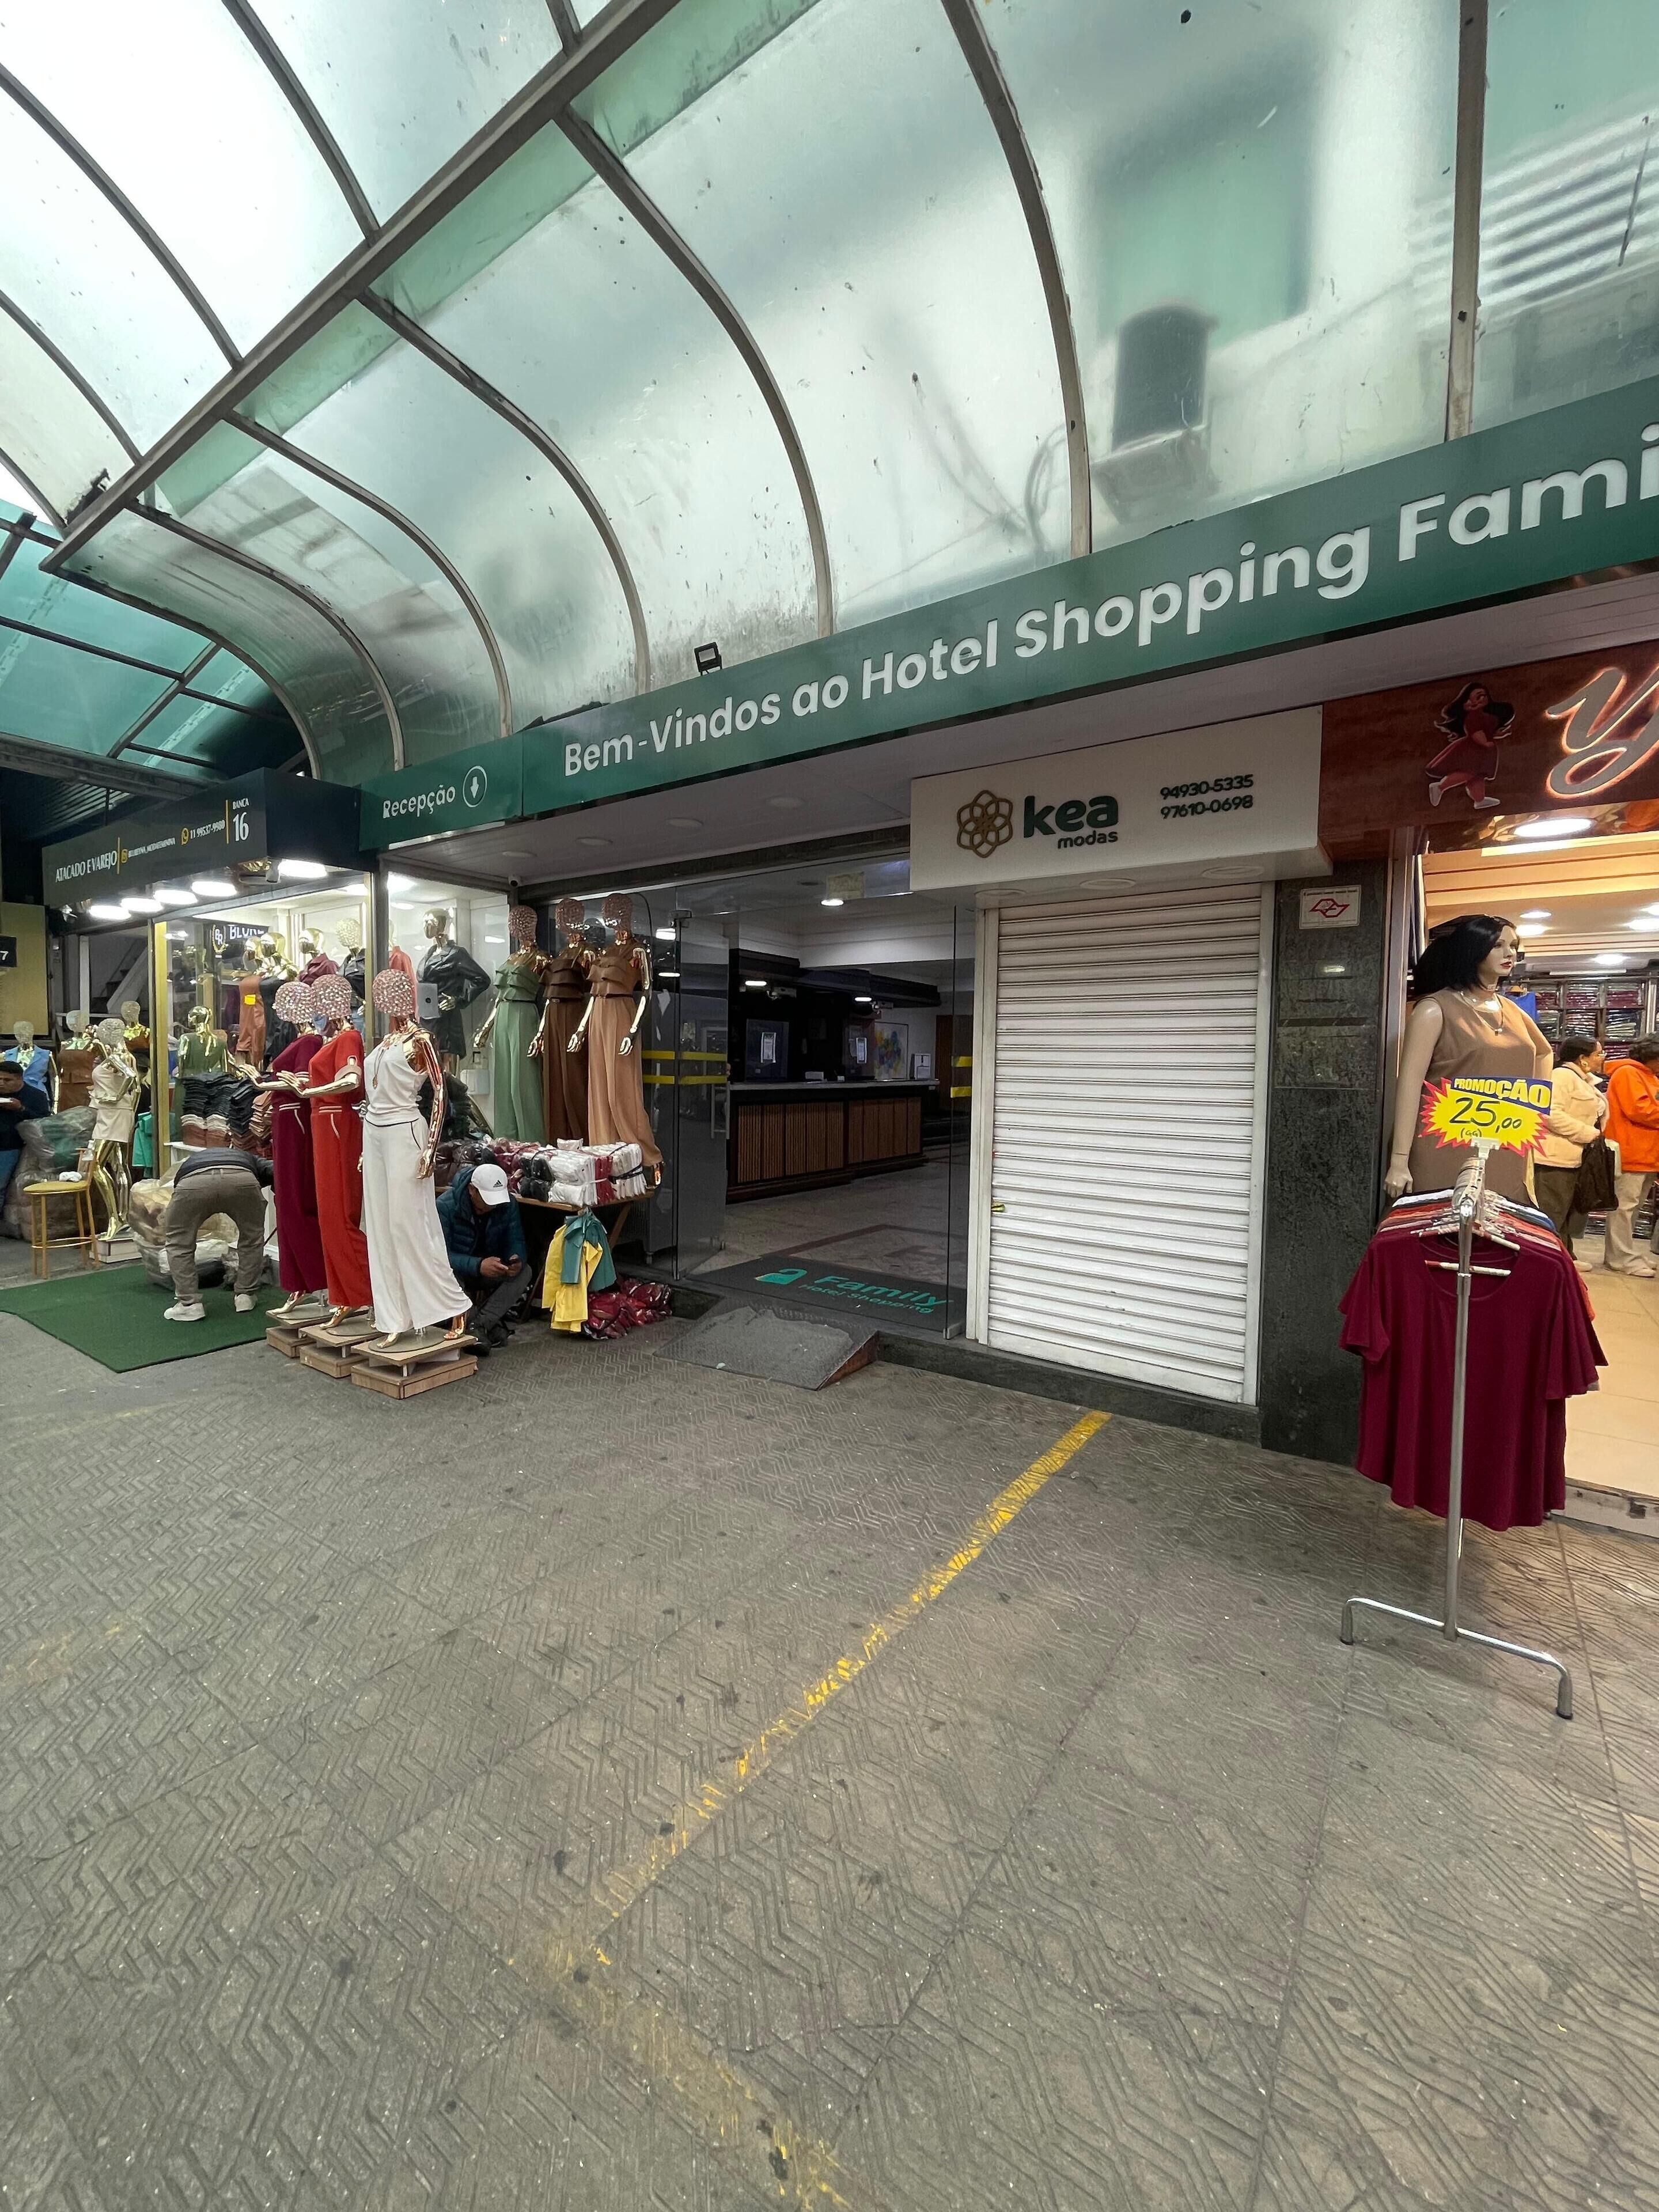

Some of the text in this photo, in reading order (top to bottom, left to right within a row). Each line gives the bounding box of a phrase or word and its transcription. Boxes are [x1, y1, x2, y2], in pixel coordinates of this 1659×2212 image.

[565, 694, 781, 777] Bem-Vindos
[792, 674, 849, 715] ao
[862, 618, 998, 700] Hotel
[1015, 525, 1370, 658] Shopping
[382, 785, 456, 819] Recepção
[1160, 774, 1253, 800] 94930-5335
[232, 798, 249, 810] BANCA
[1024, 795, 1119, 838] kea
[1160, 795, 1253, 819] 97610-0698
[190, 830, 196, 839] 11
[233, 812, 249, 841] 16
[1058, 830, 1118, 849] modas
[55, 850, 118, 882] ATACADO E VAREJO
[1453, 1078, 1551, 1108] PROMOÇÃO
[1449, 1097, 1522, 1133] 25,00
[798, 1283, 934, 1314] Hotel Shopping
[814, 1275, 954, 1306] Family
